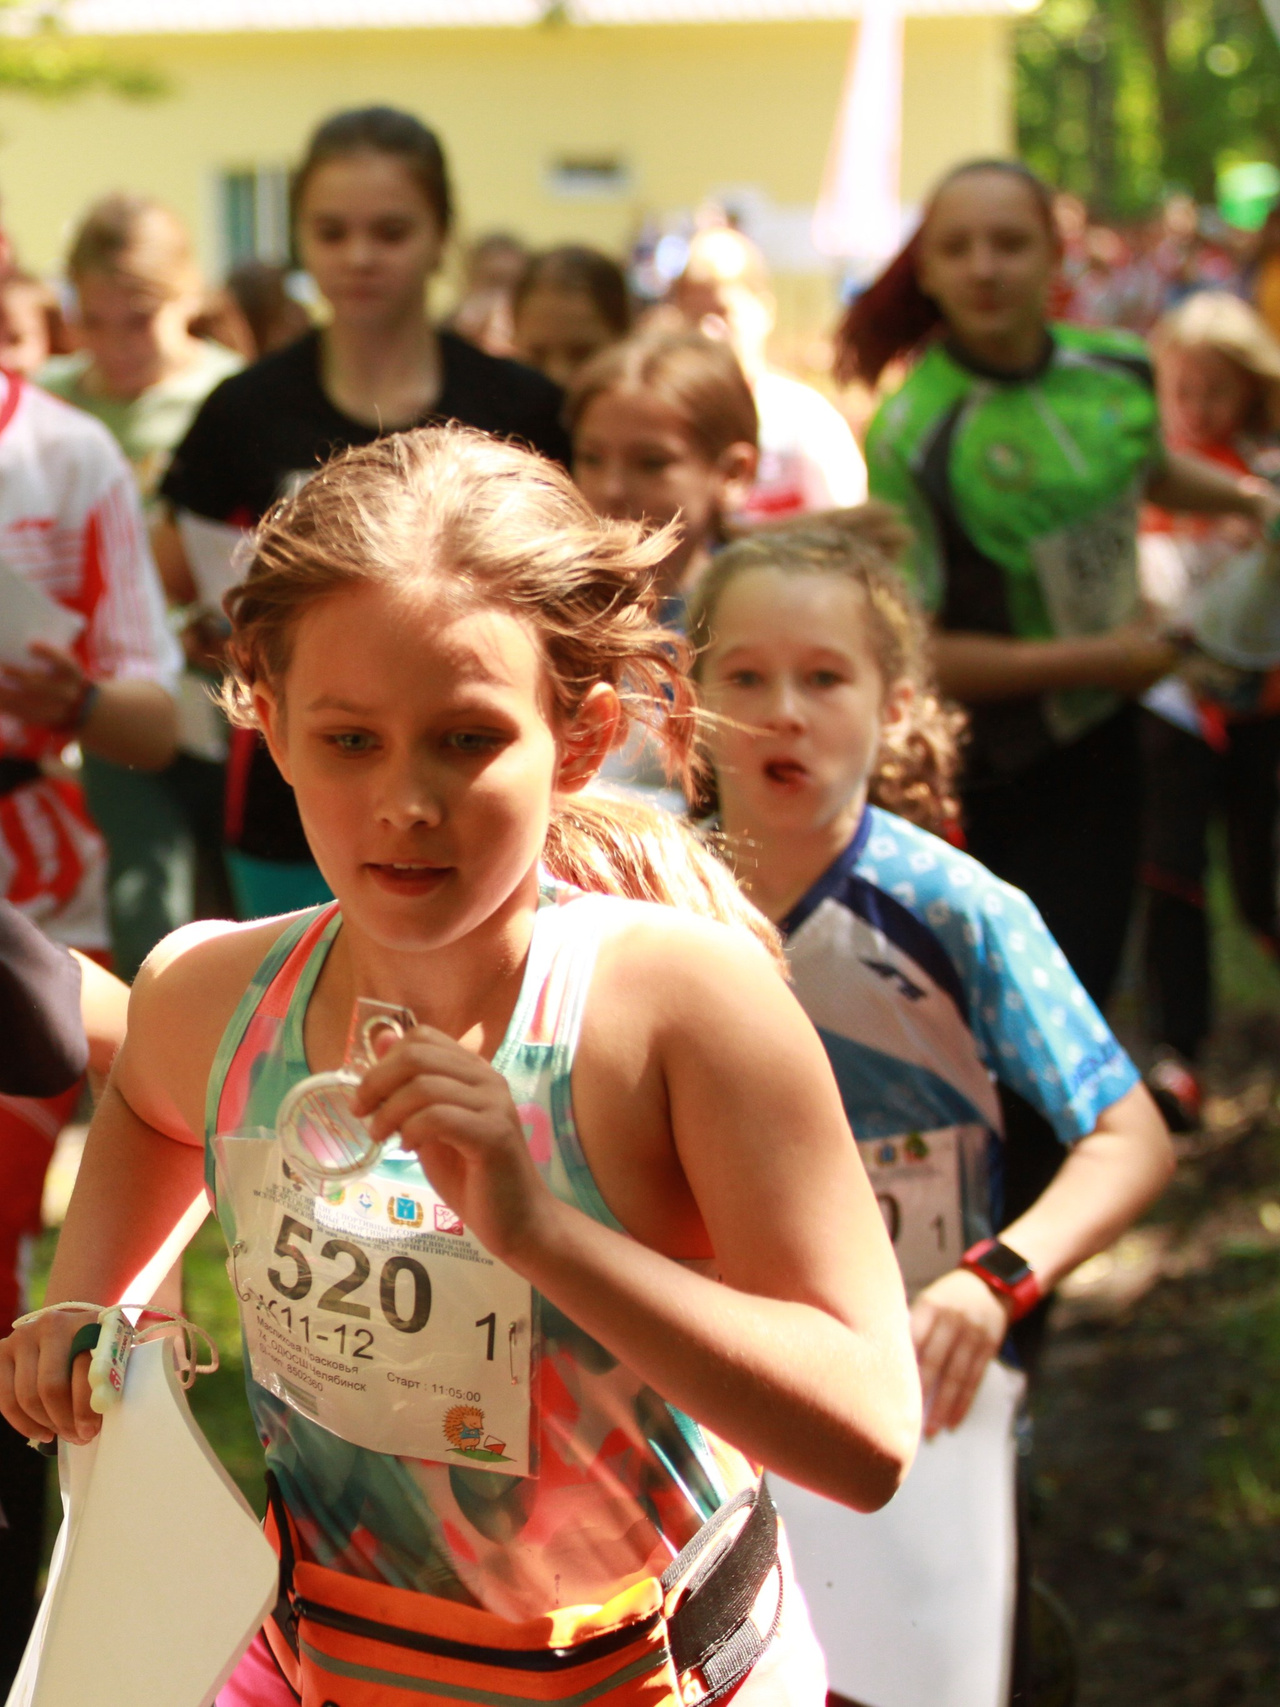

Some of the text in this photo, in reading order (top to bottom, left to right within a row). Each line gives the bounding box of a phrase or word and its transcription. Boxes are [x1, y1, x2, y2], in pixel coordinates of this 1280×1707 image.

[267, 1214, 497, 1361] 520 1
[386, 1371, 421, 1392] Старт
[431, 1383, 482, 1404] 11:05:00
